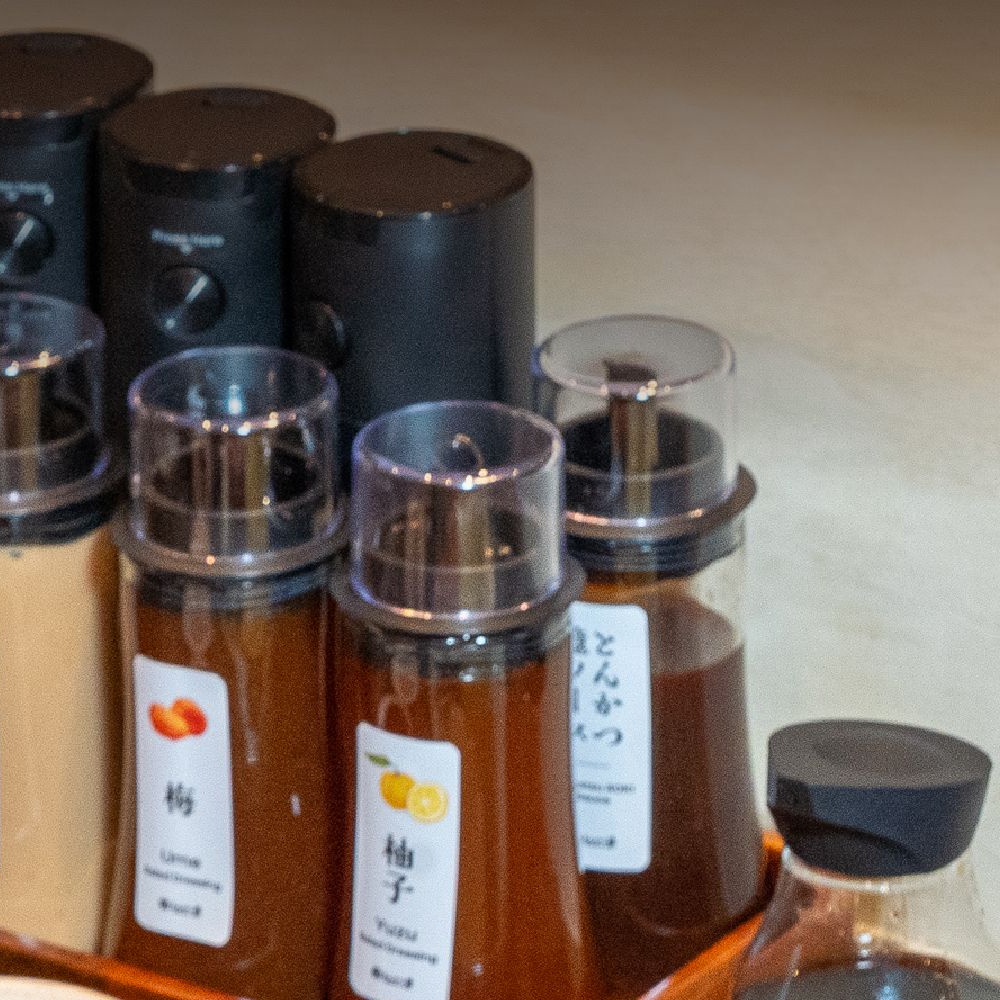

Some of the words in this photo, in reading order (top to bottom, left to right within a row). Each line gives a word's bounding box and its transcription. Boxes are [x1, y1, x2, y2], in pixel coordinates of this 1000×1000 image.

[593, 629, 623, 746] とんかつ
[383, 833, 414, 904] 柚子
